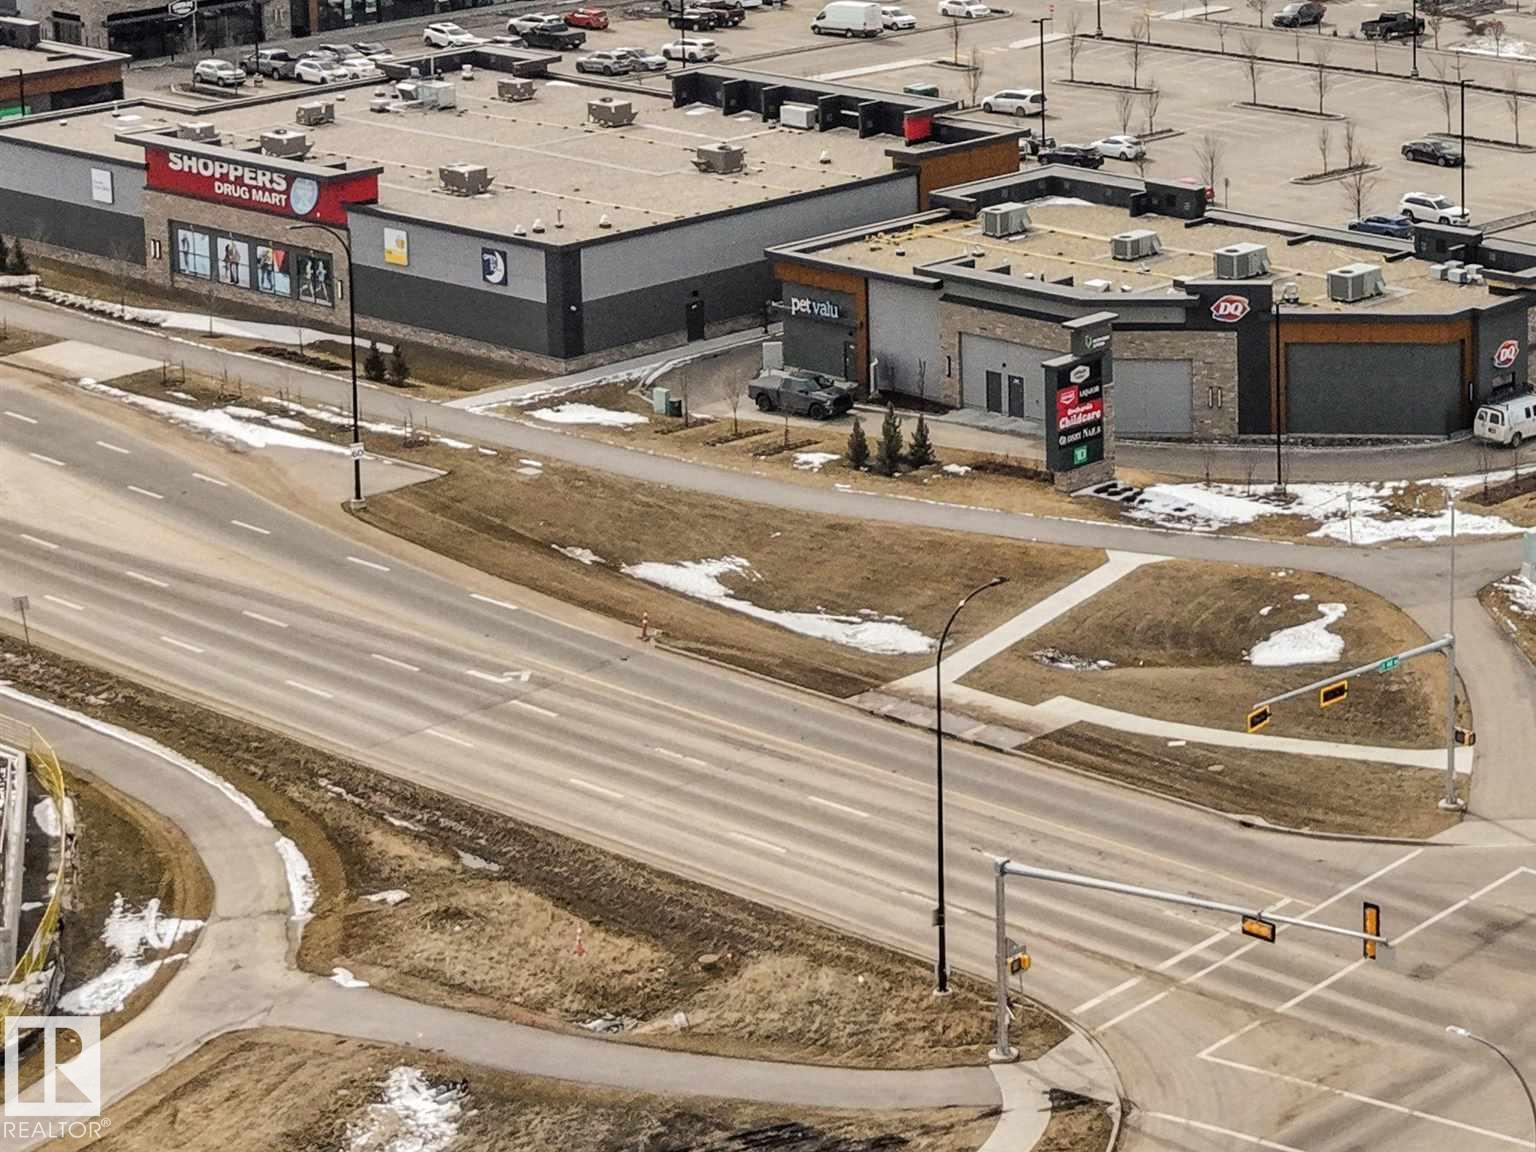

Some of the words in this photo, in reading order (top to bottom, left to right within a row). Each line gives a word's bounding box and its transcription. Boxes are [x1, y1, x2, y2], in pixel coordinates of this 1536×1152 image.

[168, 152, 288, 191] SHOPPERS
[214, 181, 250, 199] DRUG
[252, 189, 288, 208] MART
[791, 297, 811, 315] pet
[812, 301, 839, 318] valu
[1059, 410, 1101, 429] Childcare
